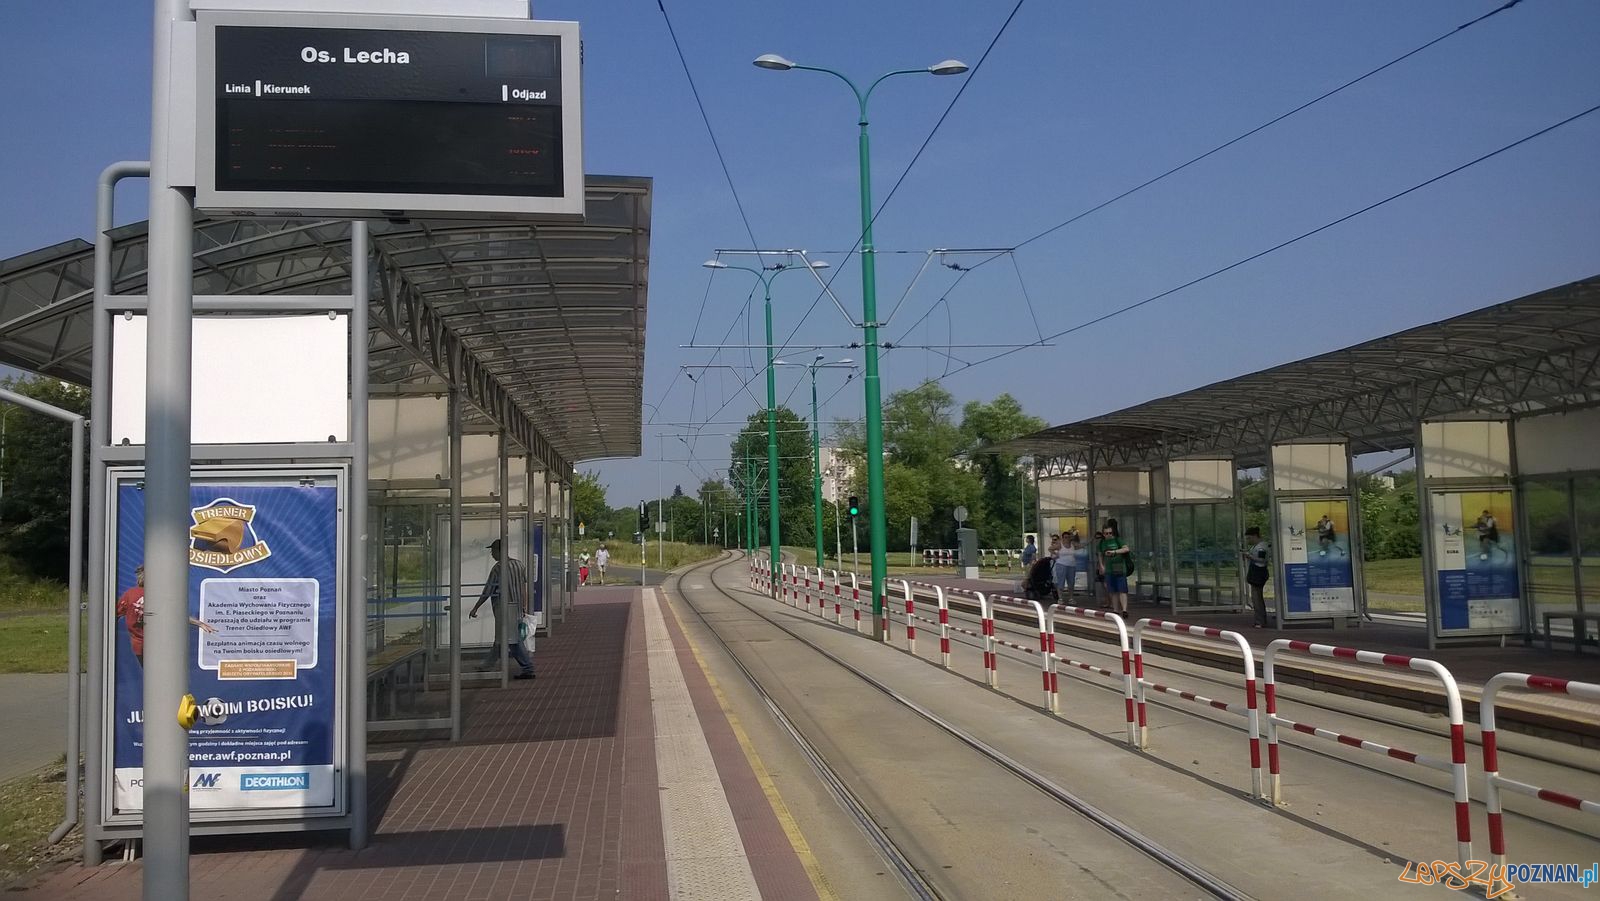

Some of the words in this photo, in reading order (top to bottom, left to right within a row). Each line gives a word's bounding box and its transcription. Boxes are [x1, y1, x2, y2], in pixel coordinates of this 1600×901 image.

[301, 46, 336, 63] Os.
[343, 47, 410, 64] Lecha
[225, 84, 251, 94] Linia
[263, 83, 311, 95] Kierunek
[511, 88, 547, 101] Odjazd
[199, 508, 247, 520] TRENER
[278, 601, 311, 609] Fizycznego
[232, 609, 268, 617] Piaseckiego
[197, 701, 242, 717] WOIM
[247, 694, 313, 713] BOISKU!
[188, 750, 291, 762] ener.awf.poznan.pl
[245, 776, 304, 787] DECATHLON
